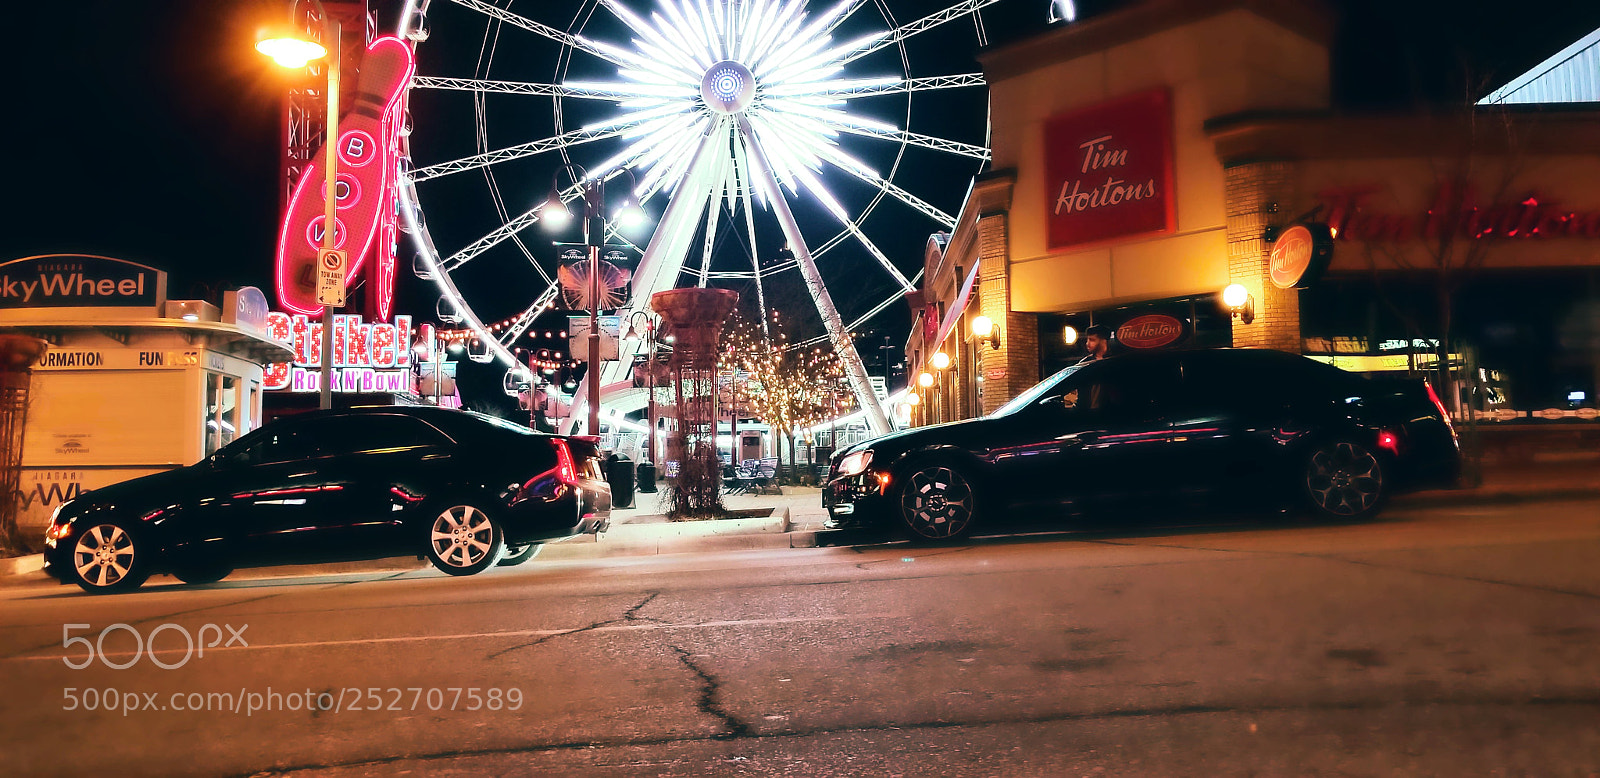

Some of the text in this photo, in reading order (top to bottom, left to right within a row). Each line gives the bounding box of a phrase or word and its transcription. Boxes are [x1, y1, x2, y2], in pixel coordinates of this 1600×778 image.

[1079, 135, 1128, 174] Tim
[1054, 176, 1155, 215] Hortons
[0, 272, 145, 303] kyWheel
[1119, 325, 1139, 340] Tim
[139, 351, 163, 366] FUN
[295, 371, 338, 390] Rok
